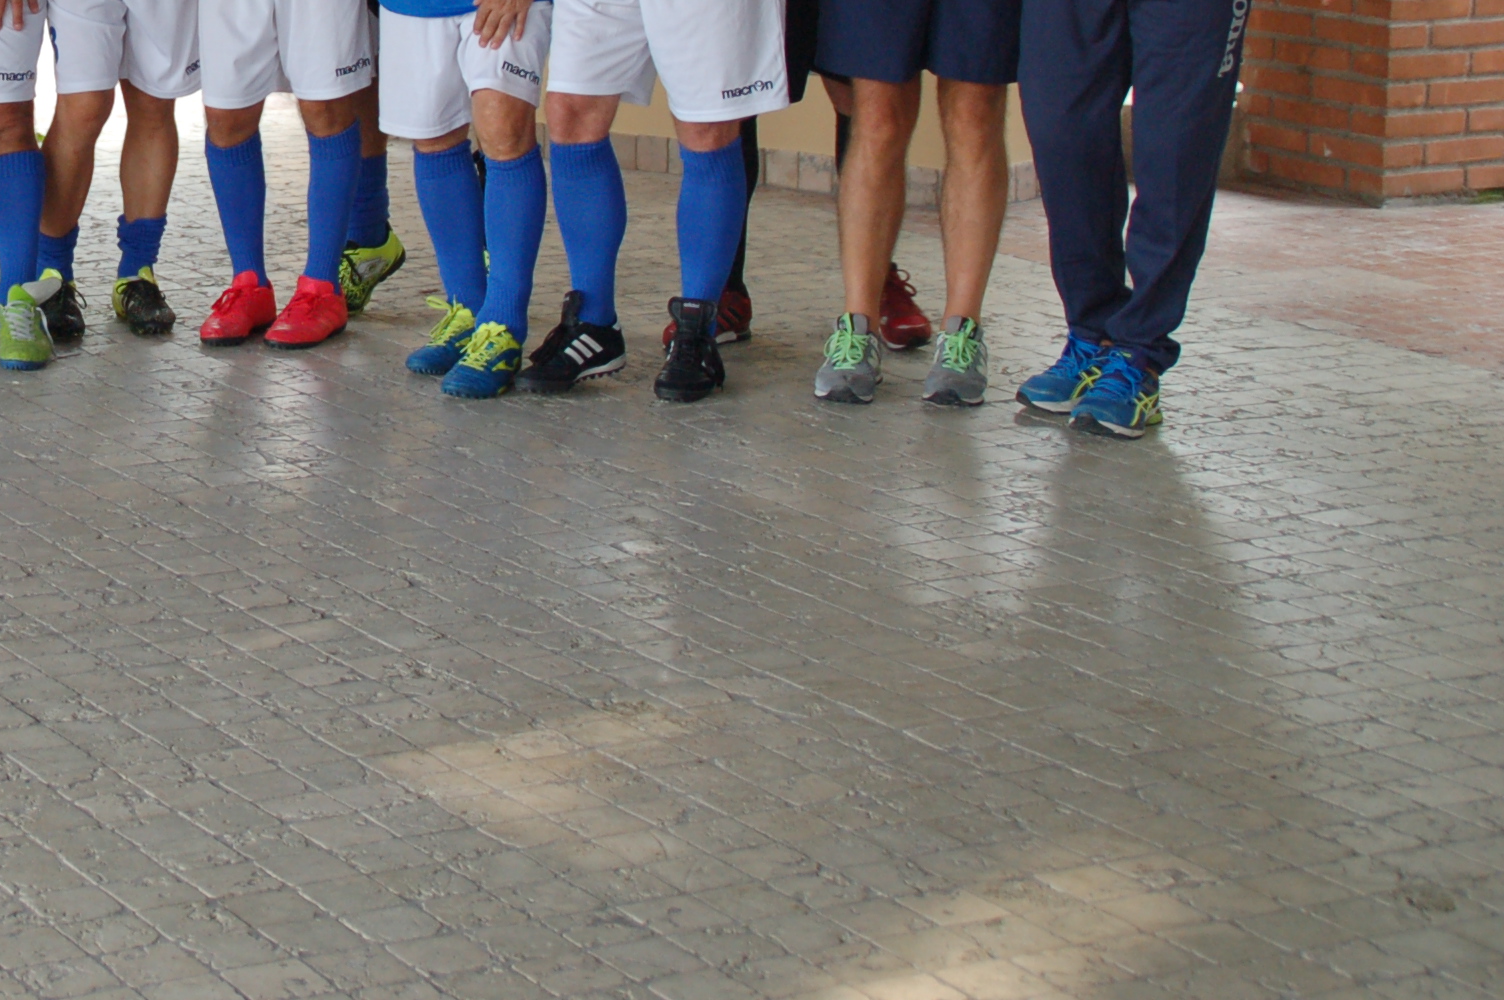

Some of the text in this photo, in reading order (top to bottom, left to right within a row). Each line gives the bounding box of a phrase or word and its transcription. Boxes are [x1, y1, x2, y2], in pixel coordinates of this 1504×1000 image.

[334, 57, 372, 77] macron
[500, 60, 541, 86] macron
[721, 79, 774, 100] macron
